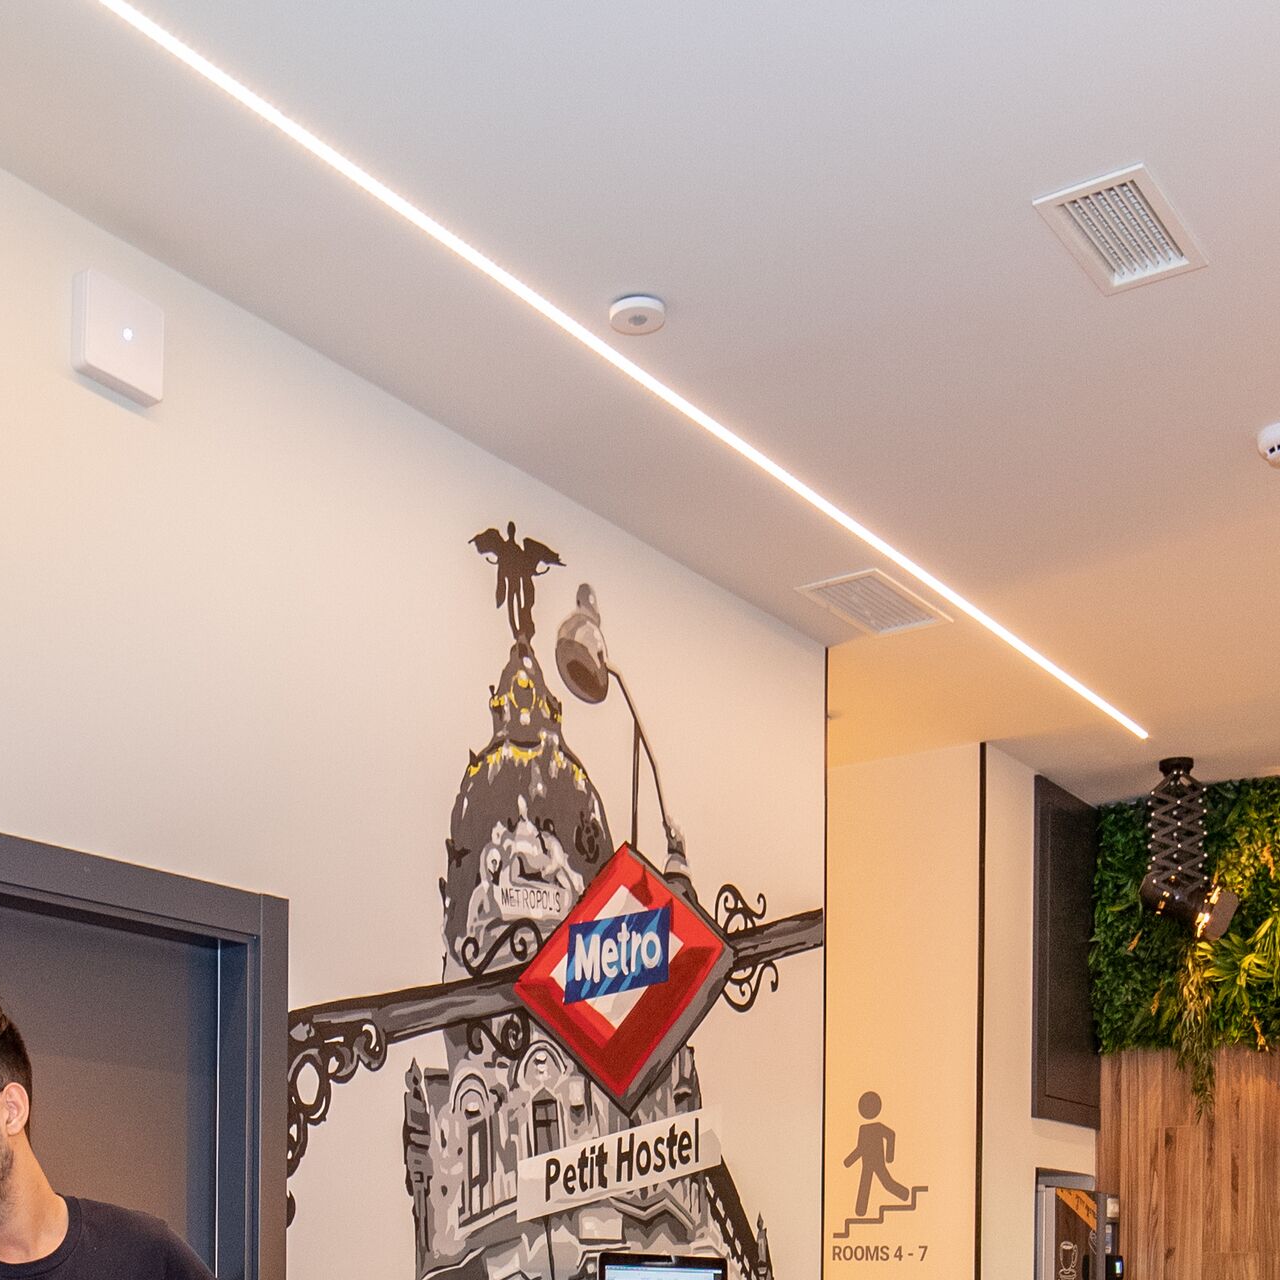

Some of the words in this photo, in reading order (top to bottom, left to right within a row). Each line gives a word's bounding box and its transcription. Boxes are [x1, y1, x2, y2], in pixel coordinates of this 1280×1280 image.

[500, 886, 561, 913] METROPOLIS
[574, 921, 662, 984] Metro
[545, 1145, 609, 1202] Petit
[616, 1117, 700, 1183] Hostel
[831, 1245, 890, 1262] ROOMS
[893, 1245, 904, 1262] 4
[917, 1245, 929, 1262] 7
